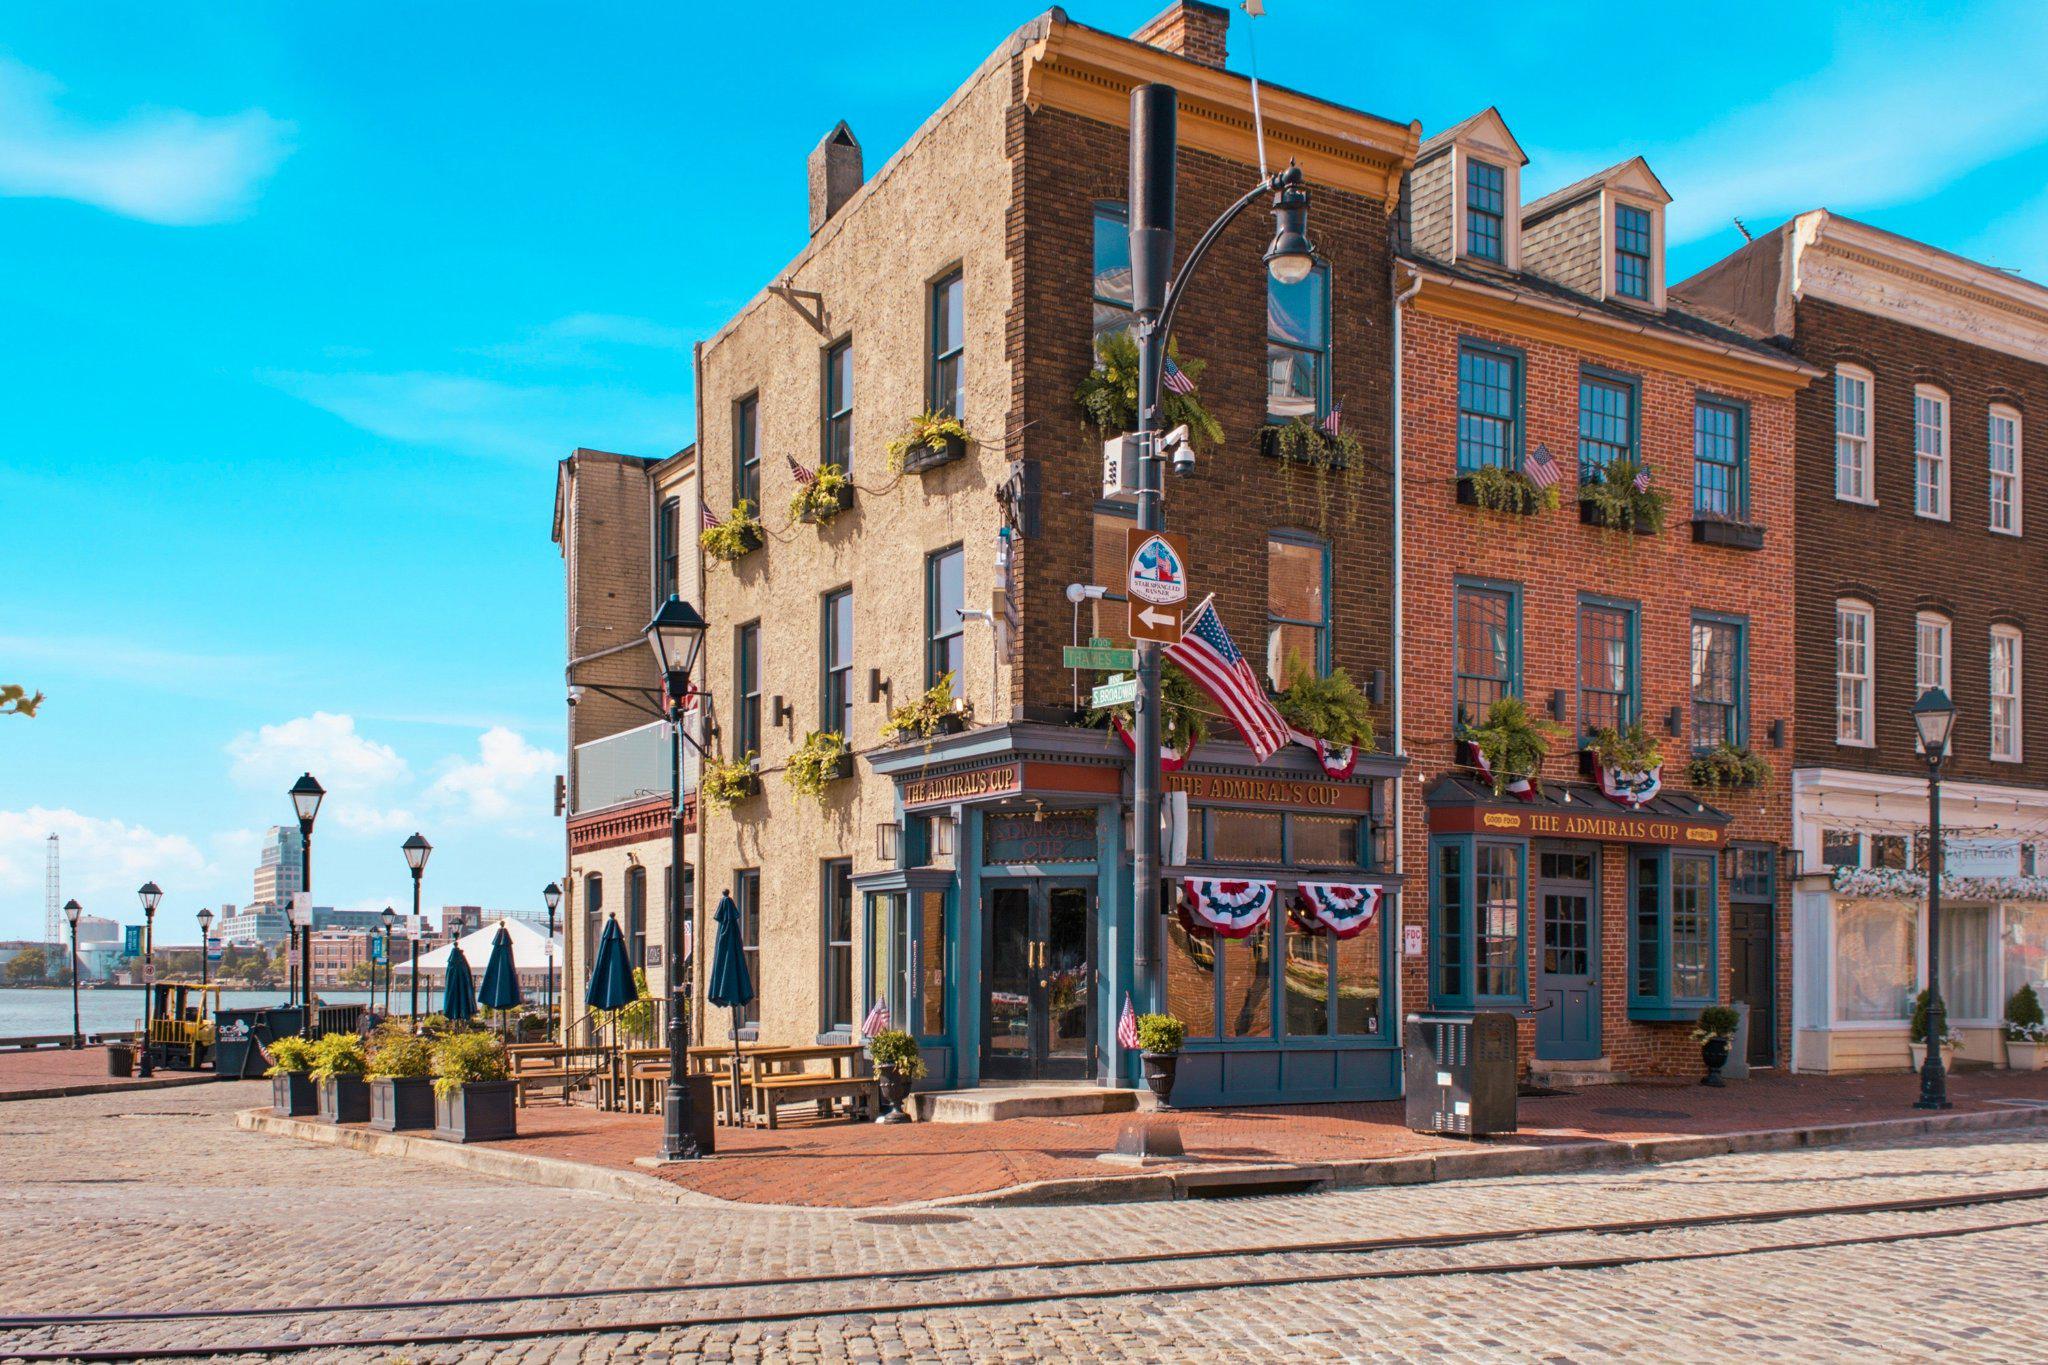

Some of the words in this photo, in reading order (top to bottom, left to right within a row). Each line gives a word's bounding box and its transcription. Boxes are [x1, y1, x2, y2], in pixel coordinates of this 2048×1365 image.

[907, 783, 926, 803] THE
[928, 773, 987, 800] ADMIRAL'S
[990, 768, 1013, 790] CUP
[1168, 775, 1204, 796] THE
[1209, 779, 1304, 803] ADMIRAL'S
[1308, 785, 1341, 805] CUP
[1486, 815, 1502, 824] GOOD
[1503, 816, 1519, 825] FOOD
[1529, 815, 1560, 832] THE
[1565, 817, 1645, 839] ADMIRALS
[1650, 822, 1679, 840] CUP
[1406, 929, 1420, 939] FDC
